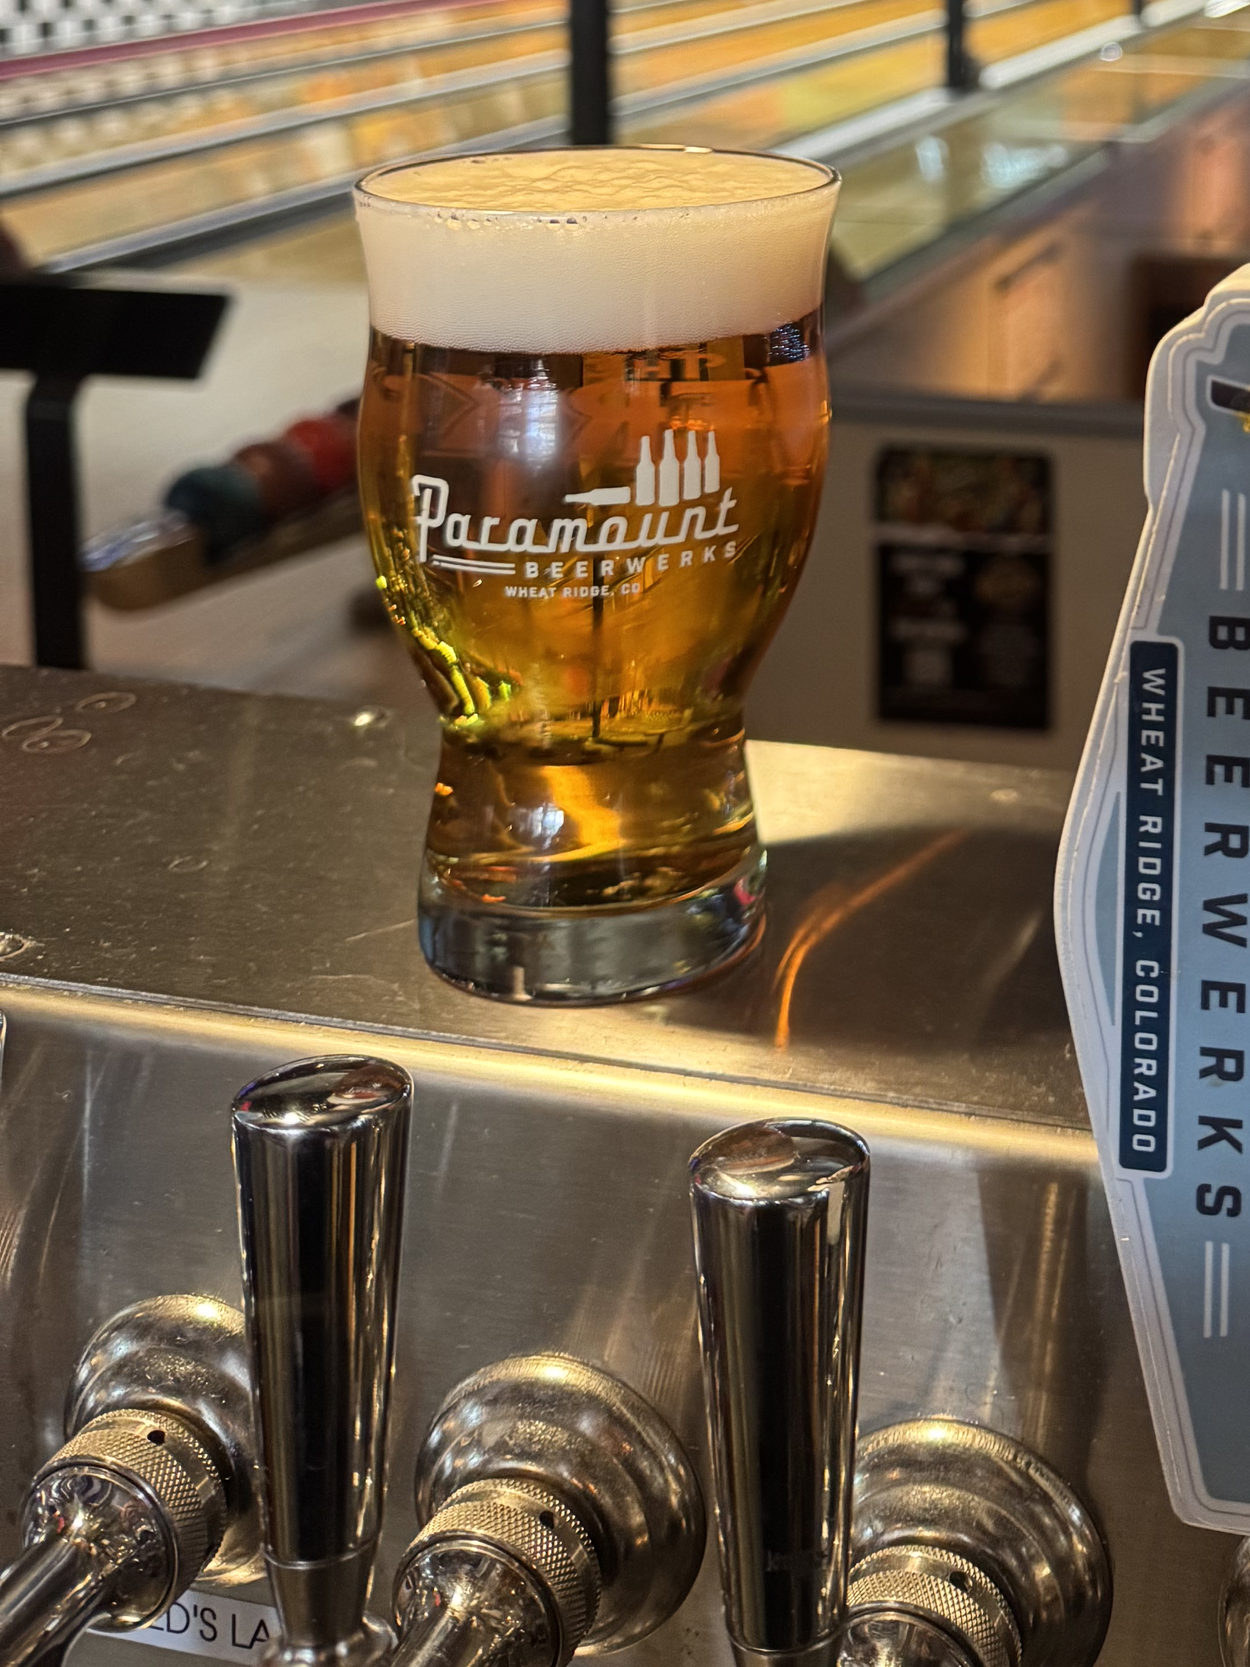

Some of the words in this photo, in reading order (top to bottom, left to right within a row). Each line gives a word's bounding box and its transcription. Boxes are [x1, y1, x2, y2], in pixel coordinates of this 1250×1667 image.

[410, 474, 740, 563] Paramount
[525, 540, 738, 579] BEERWERKS
[505, 584, 557, 598] WHEAT
[620, 582, 640, 595] CO
[1138, 667, 1168, 809] WHEAT
[1133, 815, 1166, 941] RIDGE,
[1129, 956, 1160, 1156] COLORADO
